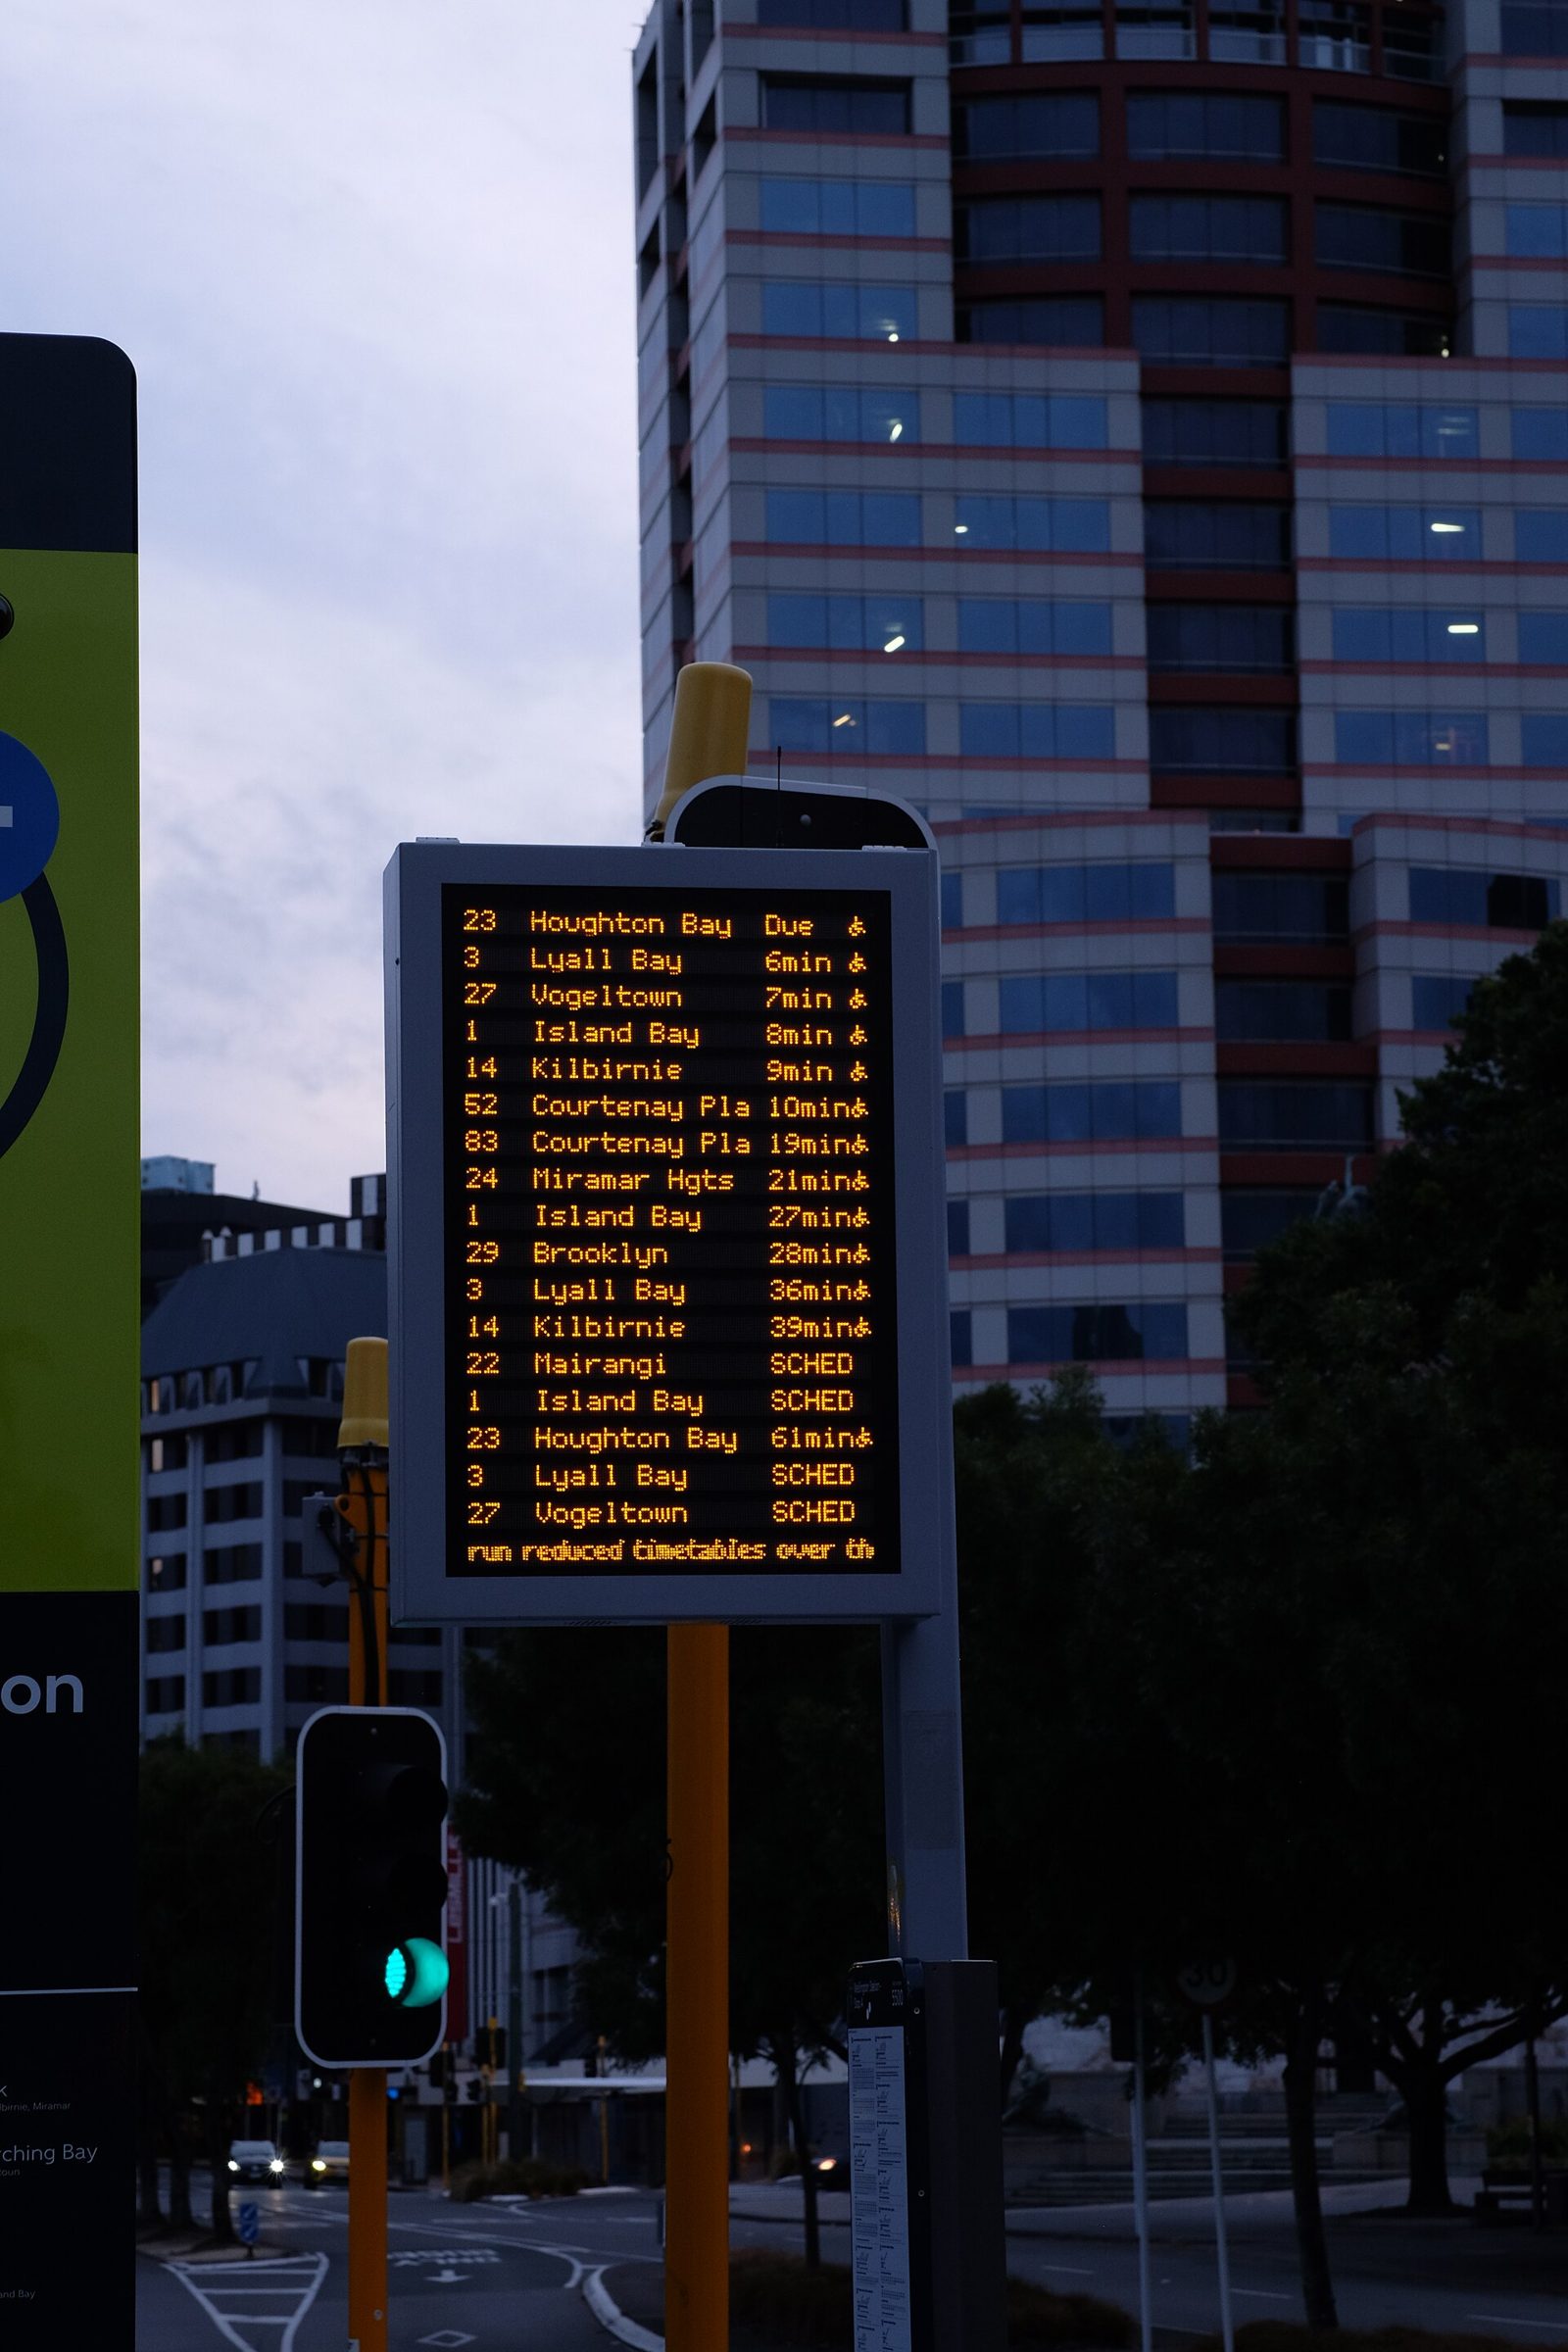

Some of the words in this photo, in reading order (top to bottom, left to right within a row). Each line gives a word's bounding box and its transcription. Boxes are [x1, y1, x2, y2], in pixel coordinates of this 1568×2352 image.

[463, 908, 497, 931] 23
[530, 909, 664, 937] Houghton
[681, 912, 732, 940] Bay
[764, 913, 814, 937] Due
[464, 946, 480, 968] 3
[530, 947, 612, 973] Lyall
[631, 949, 682, 976] Bay
[764, 950, 832, 973] 6min
[464, 982, 497, 1004] 27
[531, 983, 682, 1011] Vogeltown
[765, 986, 832, 1009] 7min
[466, 1019, 477, 1042] 1
[534, 1020, 632, 1044] Island
[649, 1021, 700, 1050] Bay
[765, 1022, 832, 1046] 8min
[467, 1056, 498, 1079] 14
[531, 1056, 683, 1081] Kilbirnie
[766, 1059, 833, 1082] 9min
[464, 1093, 498, 1115] 52
[532, 1094, 683, 1122] Courtenay
[700, 1095, 751, 1117] Pla
[769, 1096, 853, 1118] 10min
[465, 1129, 499, 1152] 83
[532, 1130, 684, 1159] Courtenay
[700, 1132, 751, 1154] Pla
[770, 1132, 853, 1155] 19min
[466, 1167, 499, 1189] 24
[532, 1167, 651, 1191] Miramar
[667, 1168, 734, 1197] Hgts
[768, 1169, 854, 1192] 21min
[468, 1203, 479, 1226] 1
[536, 1204, 634, 1227] Island
[651, 1204, 702, 1233] Bay
[768, 1204, 855, 1228] 27min
[466, 1241, 500, 1263] 29
[533, 1241, 668, 1270] Brooklyn
[769, 1242, 855, 1264] 28min
[466, 1278, 482, 1300] 3
[533, 1278, 615, 1306] Lyall
[635, 1278, 686, 1306] Bay
[769, 1279, 855, 1301] 36min
[468, 1315, 500, 1338] 14
[533, 1315, 686, 1338] Kilbirnie
[769, 1315, 856, 1339] 39min
[466, 1351, 500, 1375] 22
[534, 1351, 666, 1381] Mairangi
[770, 1352, 854, 1375] SCHED
[469, 1390, 480, 1412] 1
[538, 1389, 636, 1412] Island
[653, 1389, 704, 1417] Bay
[770, 1389, 854, 1412] SCHED
[466, 1427, 501, 1449] 23
[534, 1426, 670, 1454] Houghton
[687, 1426, 738, 1454] Bay
[770, 1426, 858, 1448] 61min
[466, 1464, 483, 1487] 3
[535, 1464, 616, 1493] Lyall
[637, 1463, 688, 1492] Bay
[771, 1463, 855, 1486] SCHED
[467, 1501, 501, 1525] 27
[535, 1501, 688, 1530] Vogeltown
[772, 1499, 856, 1523] SCHED
[466, 1544, 513, 1562] run
[521, 1539, 626, 1561] reduced
[632, 1538, 767, 1561] timetables
[775, 1541, 837, 1560] over
[0, 2143, 56, 2165] ching
[63, 2142, 98, 2164] Bay
